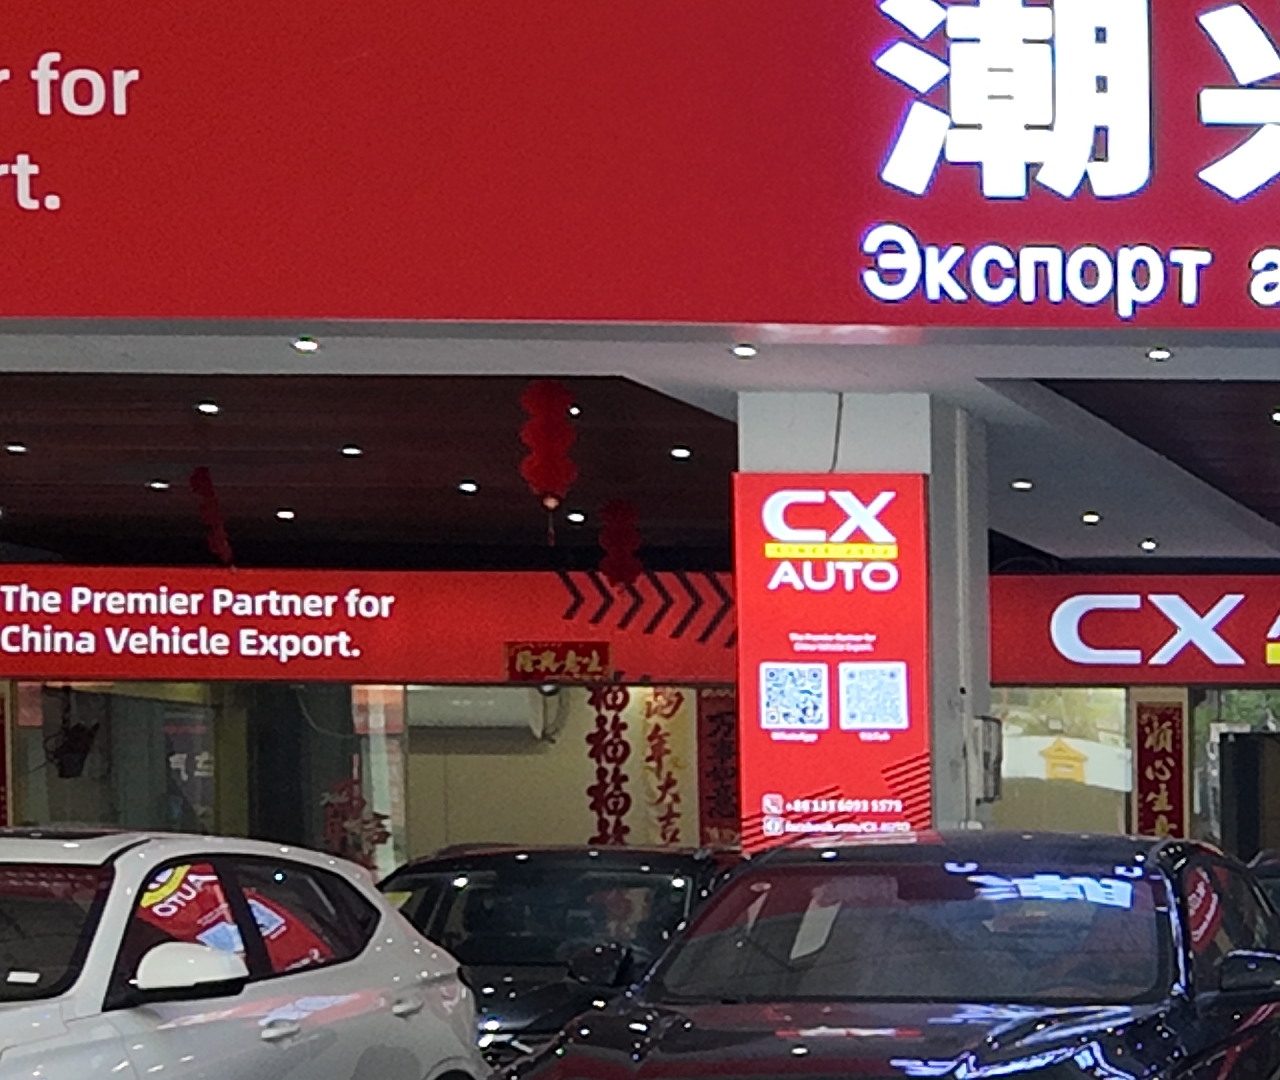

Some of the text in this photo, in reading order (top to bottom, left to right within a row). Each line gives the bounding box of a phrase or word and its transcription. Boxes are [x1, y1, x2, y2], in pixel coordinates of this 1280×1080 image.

[30, 51, 140, 116] for
[861, 223, 1211, 317] Экспорт
[762, 489, 897, 543] CX
[0, 584, 395, 618] The Premier Partner for
[767, 560, 898, 592] AUTO
[0, 625, 361, 662] China Vehicle Export.
[1050, 594, 1245, 665] CX
